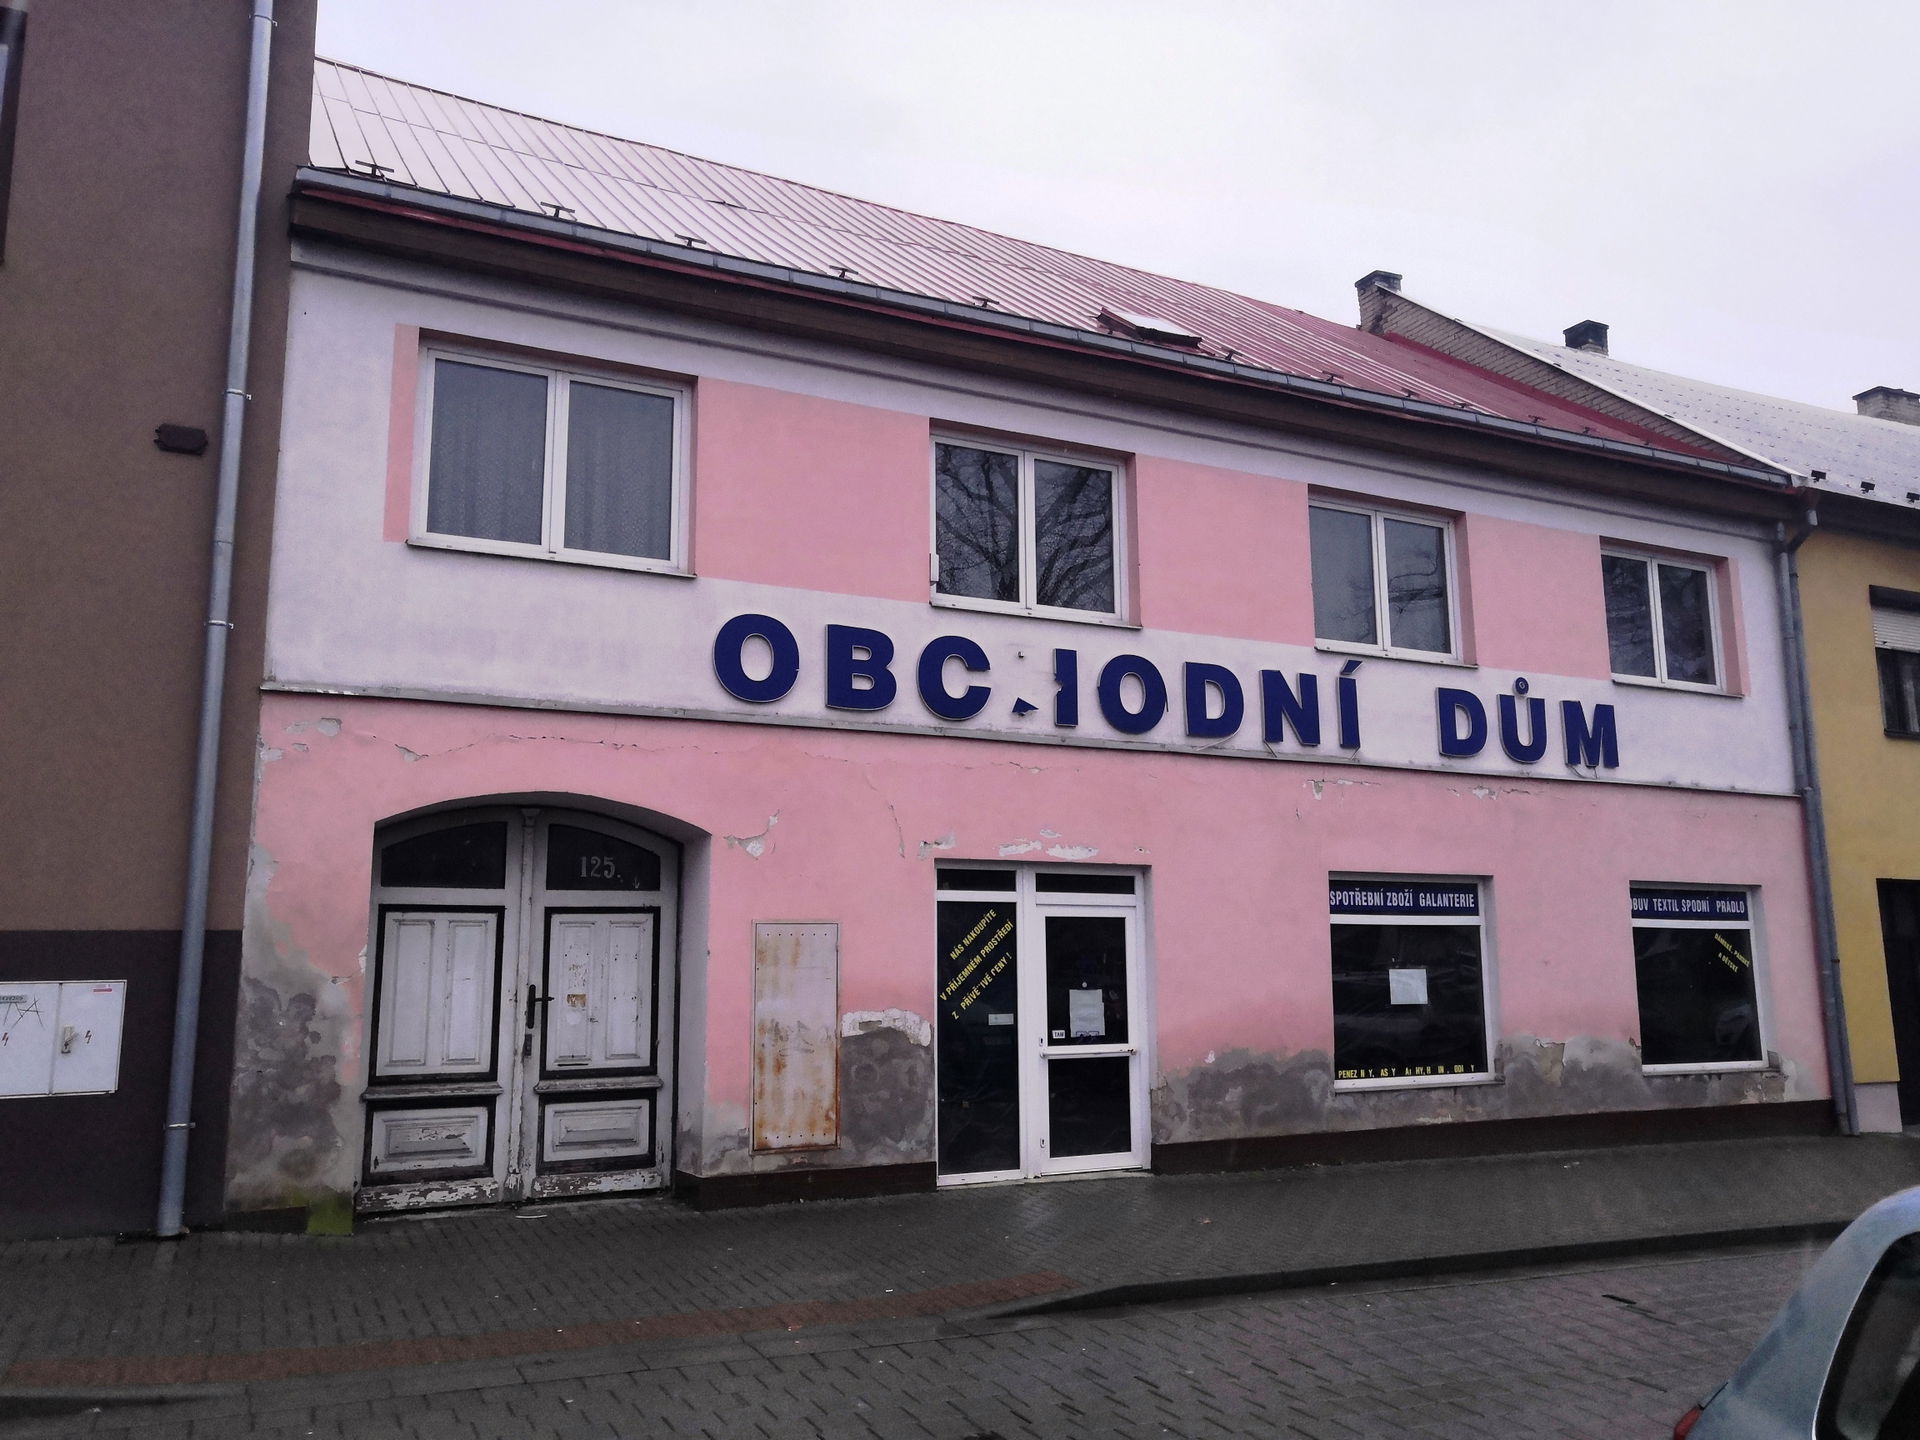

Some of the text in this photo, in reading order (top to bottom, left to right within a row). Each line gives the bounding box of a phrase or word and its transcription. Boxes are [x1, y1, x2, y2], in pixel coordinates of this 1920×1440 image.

[1435, 677, 1620, 768] DŮM
[1329, 888, 1475, 908] SPOTŘEBNÍ ZBOŽÍ GALANTERIE
[1631, 896, 1745, 914] BUV TEXTIL SPODNÍ PRÁDLO
[950, 908, 997, 960] NÁS NAKOUPÍTE
[940, 918, 1014, 1001] V PŘÍJEMNÉM PROSTŘEDÍ
[960, 972, 993, 1010] PŘÍVĚIVÉ
